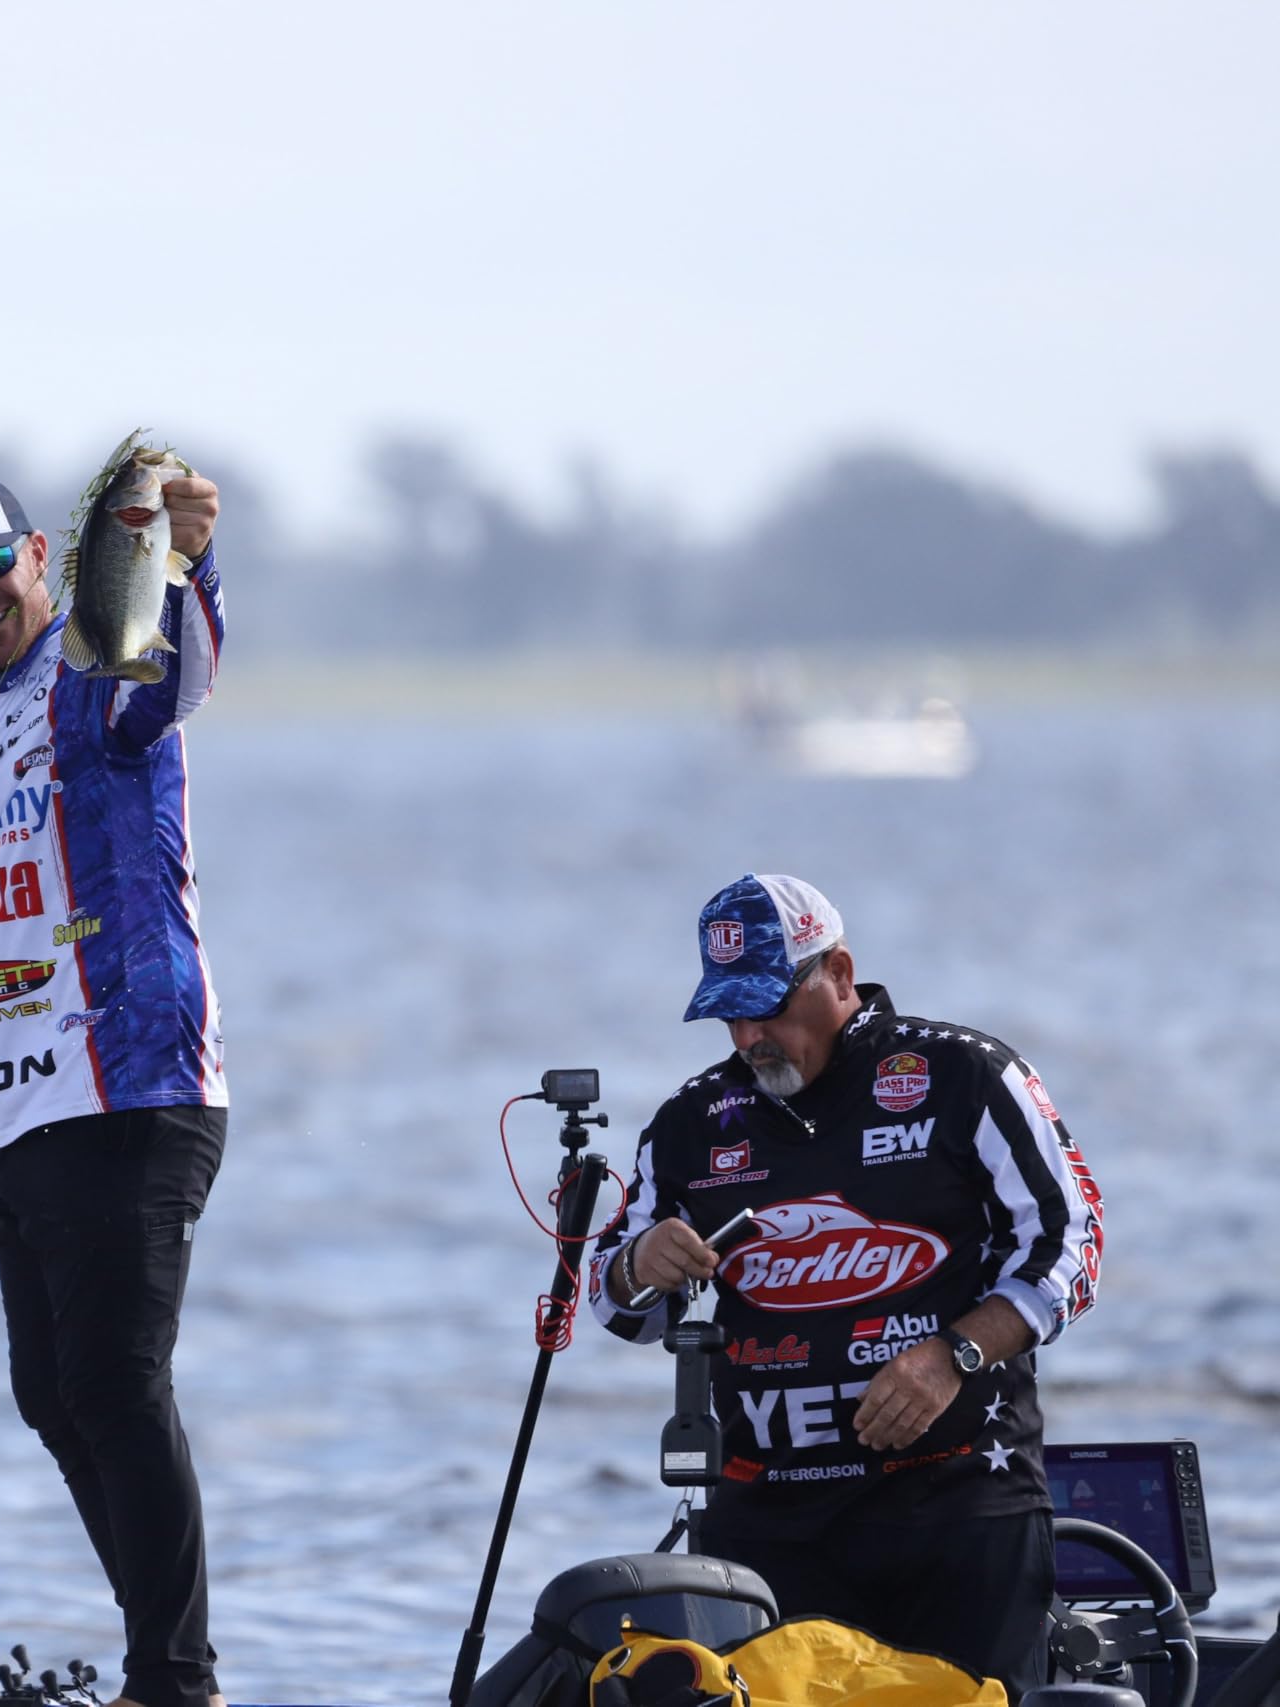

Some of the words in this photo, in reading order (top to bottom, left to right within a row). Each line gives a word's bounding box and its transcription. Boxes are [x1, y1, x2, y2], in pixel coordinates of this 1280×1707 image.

[53, 917, 102, 946] Sufix
[709, 928, 741, 949] MLF
[876, 1077, 905, 1090] BASS
[906, 1077, 927, 1087] PRO
[891, 1087, 913, 1095] TOUR
[862, 1155, 893, 1167] TRAILER
[894, 1150, 928, 1162] HITCHES
[688, 1174, 741, 1189] GENERAL
[741, 1169, 770, 1182] TIRE
[736, 1237, 921, 1293] Berkley
[882, 1313, 940, 1341] Abu
[737, 1380, 871, 1449] YE
[780, 1463, 865, 1481] FERGUSON
